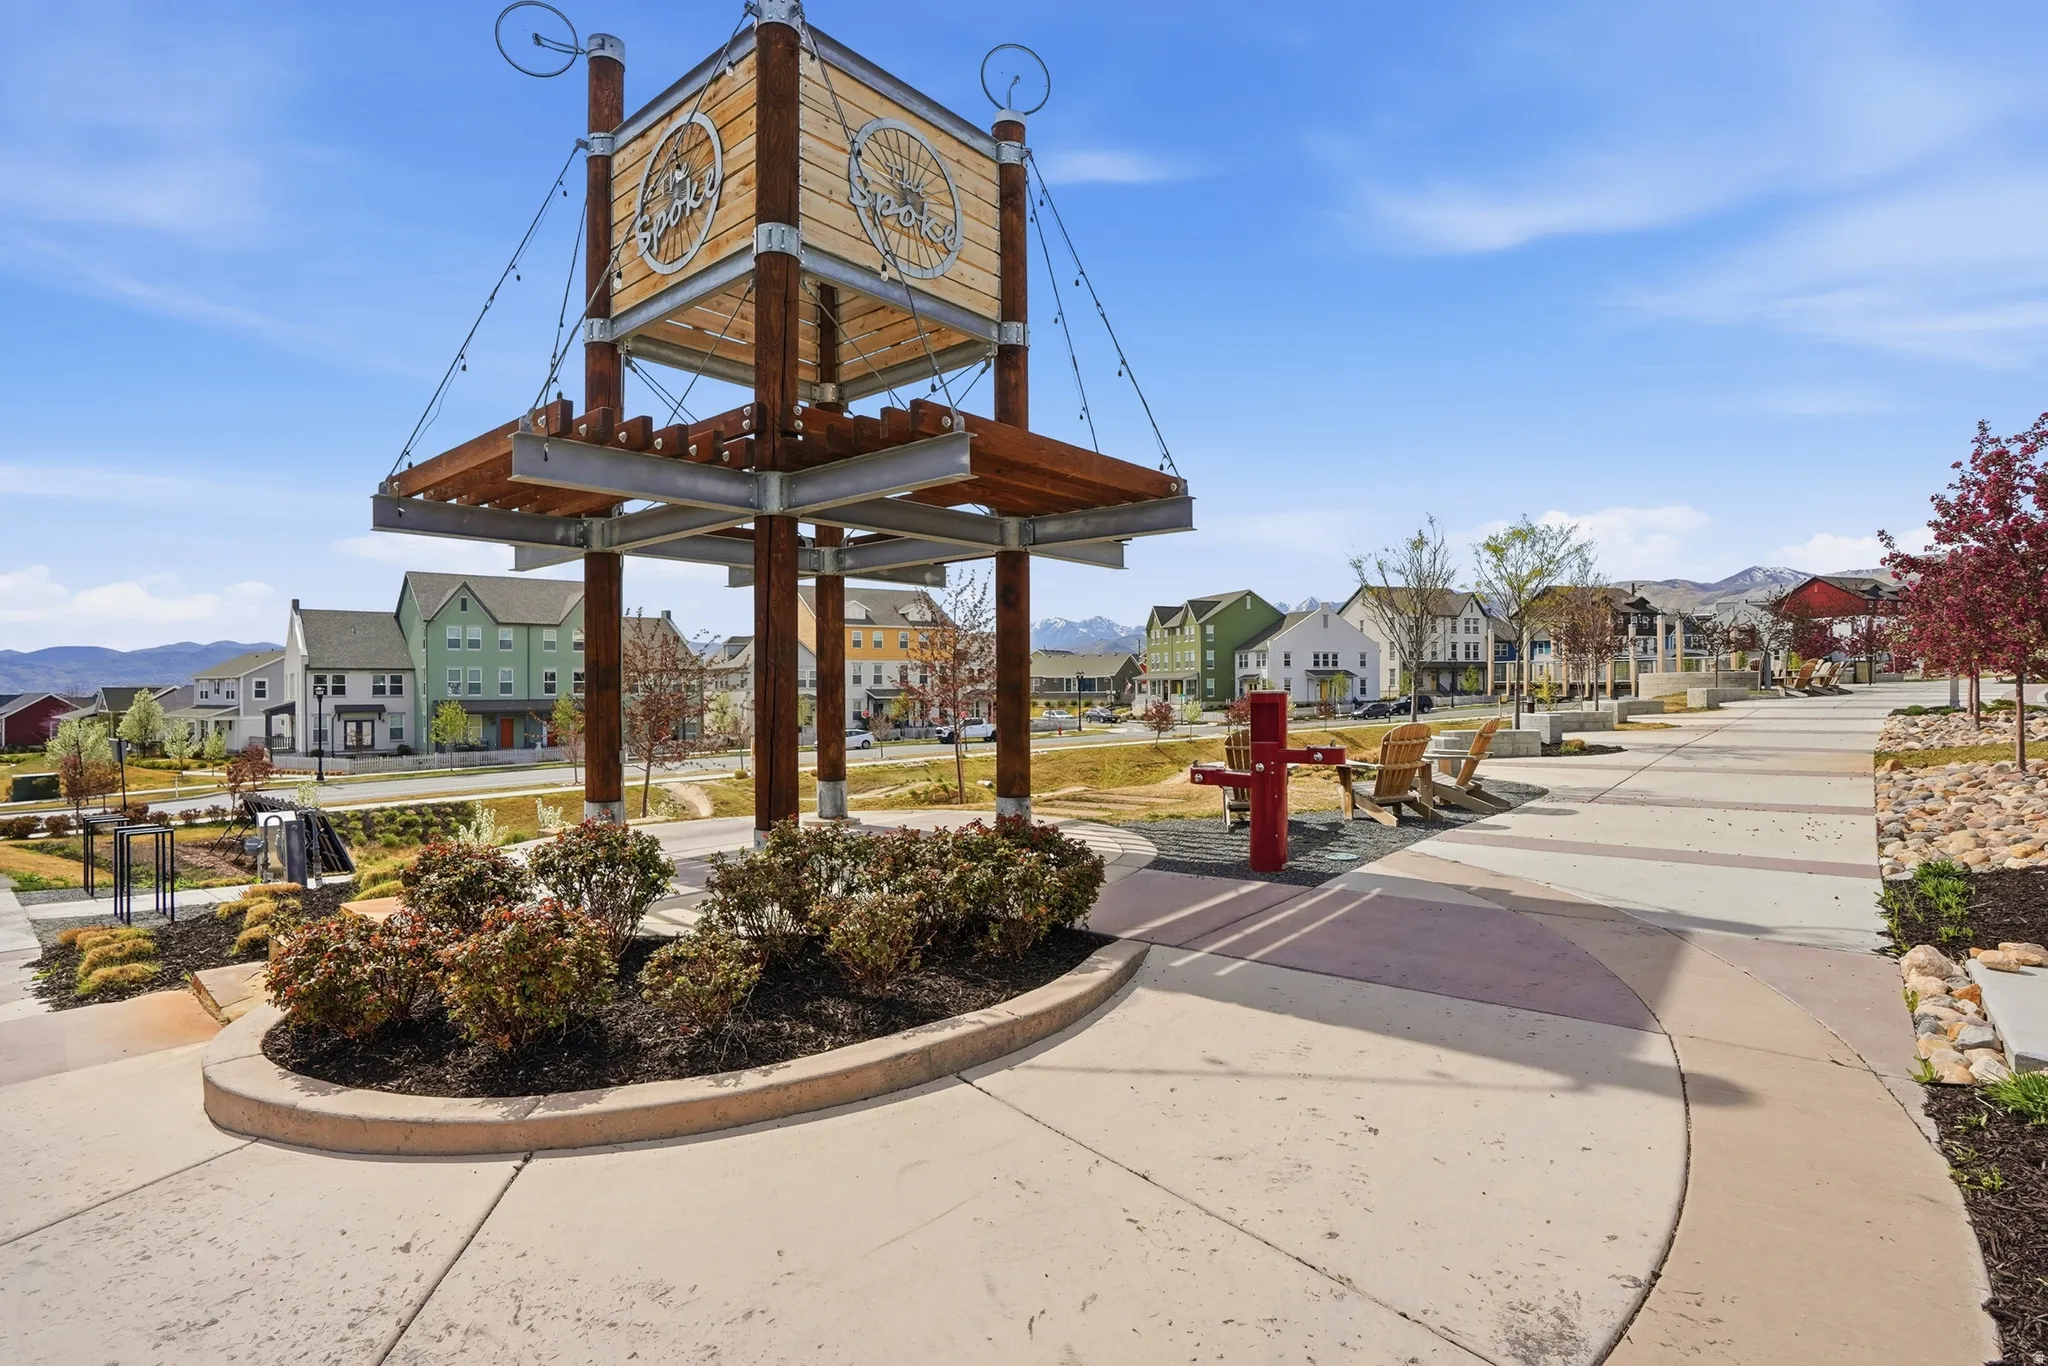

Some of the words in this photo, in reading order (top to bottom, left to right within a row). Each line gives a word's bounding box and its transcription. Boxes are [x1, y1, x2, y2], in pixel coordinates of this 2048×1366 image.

[637, 167, 724, 257] Spoke
[849, 170, 964, 252] Spoke
[885, 161, 928, 198] The
